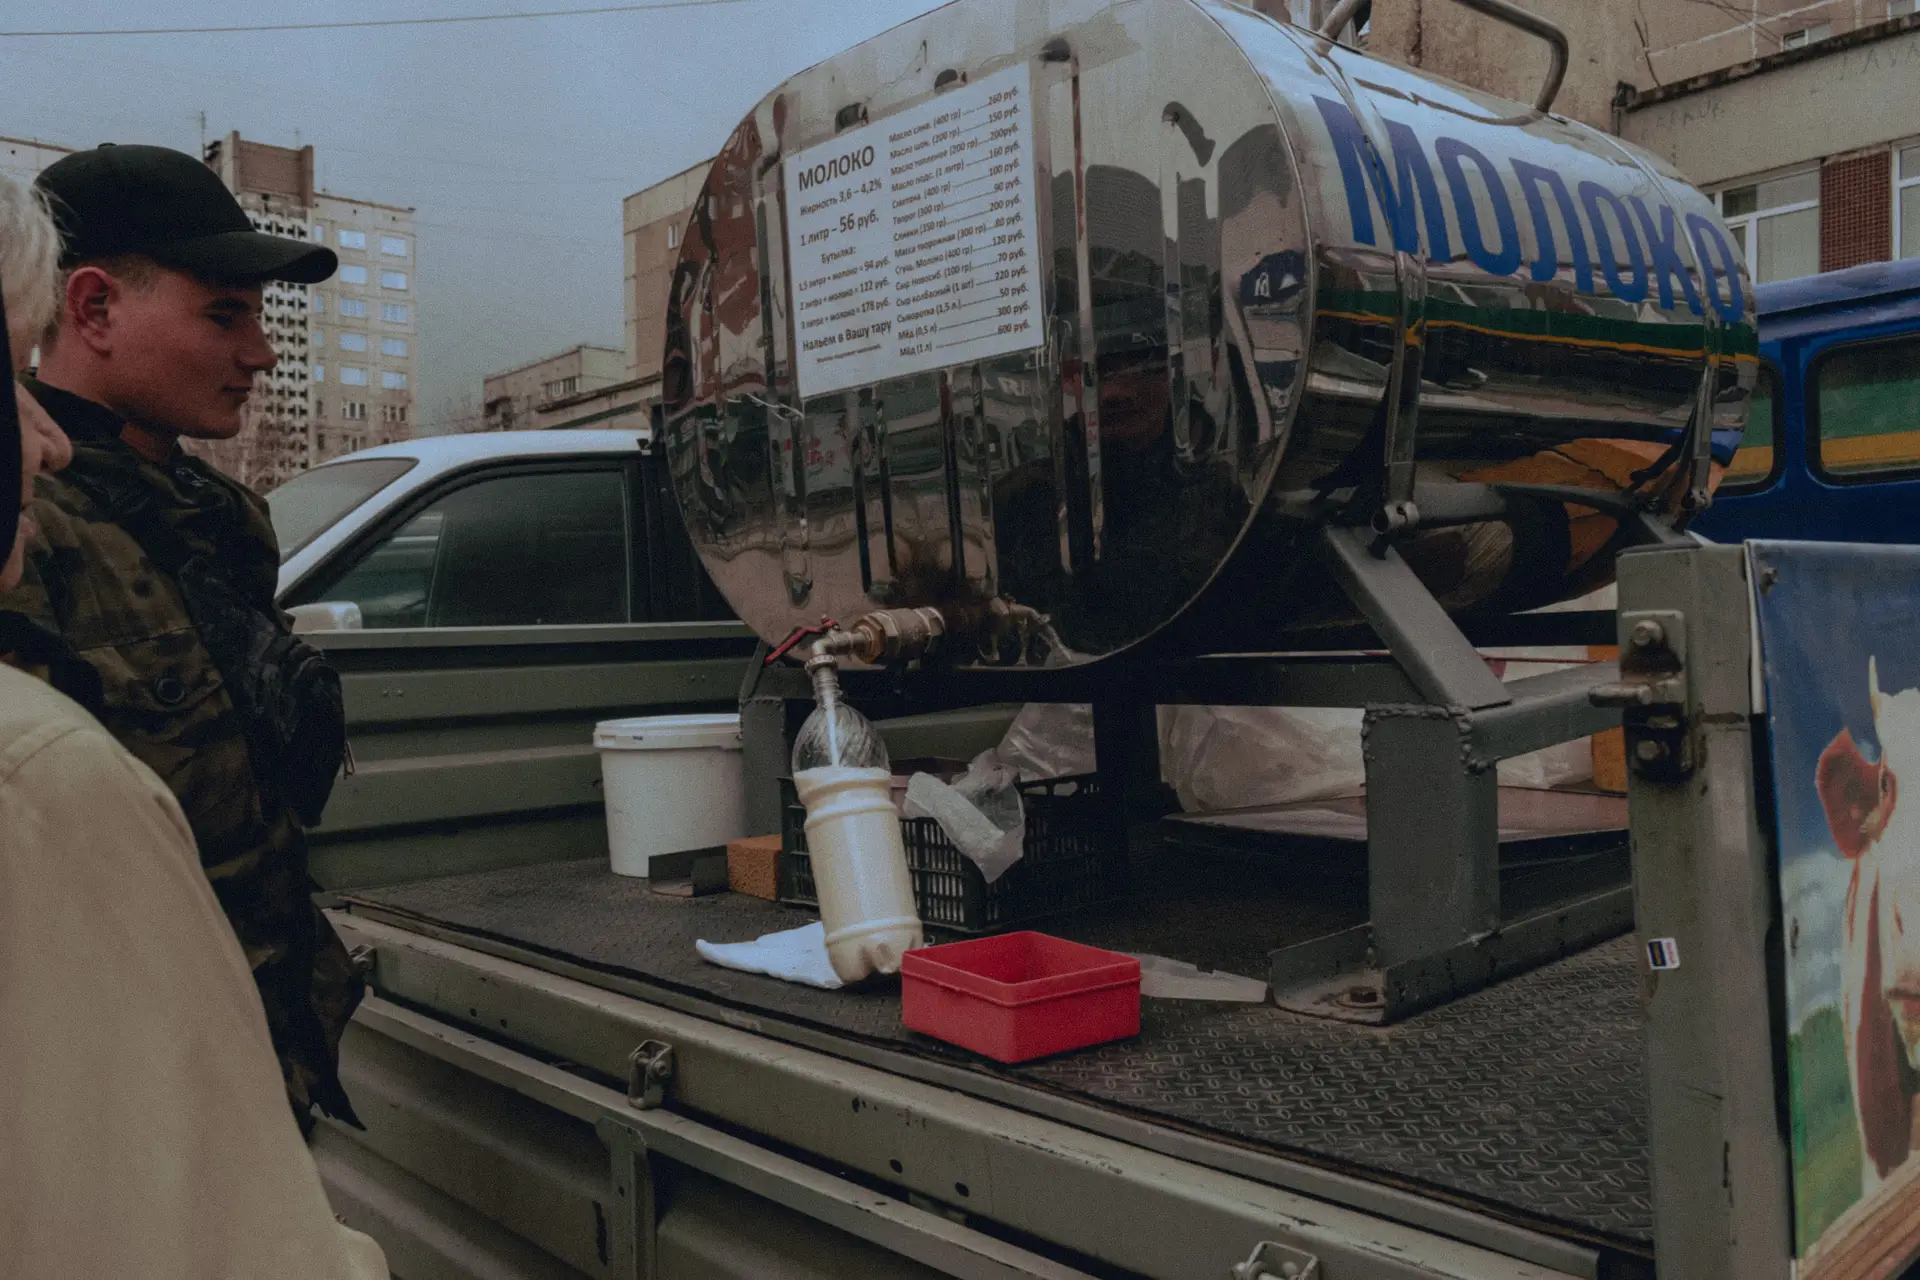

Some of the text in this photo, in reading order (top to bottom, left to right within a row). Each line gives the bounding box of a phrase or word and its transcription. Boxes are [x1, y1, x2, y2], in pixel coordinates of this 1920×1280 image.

[1004, 104, 1020, 119] руб.
[798, 145, 875, 191] МОЛОКО
[800, 197, 838, 216] Жирность
[839, 188, 852, 202] 3,6
[861, 179, 882, 194] 4,2%
[1311, 94, 1744, 323] МОЛОКО
[808, 228, 829, 244] литр
[840, 213, 855, 233] 56
[857, 209, 879, 230] руб.
[1009, 247, 1026, 261] руб.
[845, 327, 870, 341] Вашу
[871, 321, 892, 334] тару
